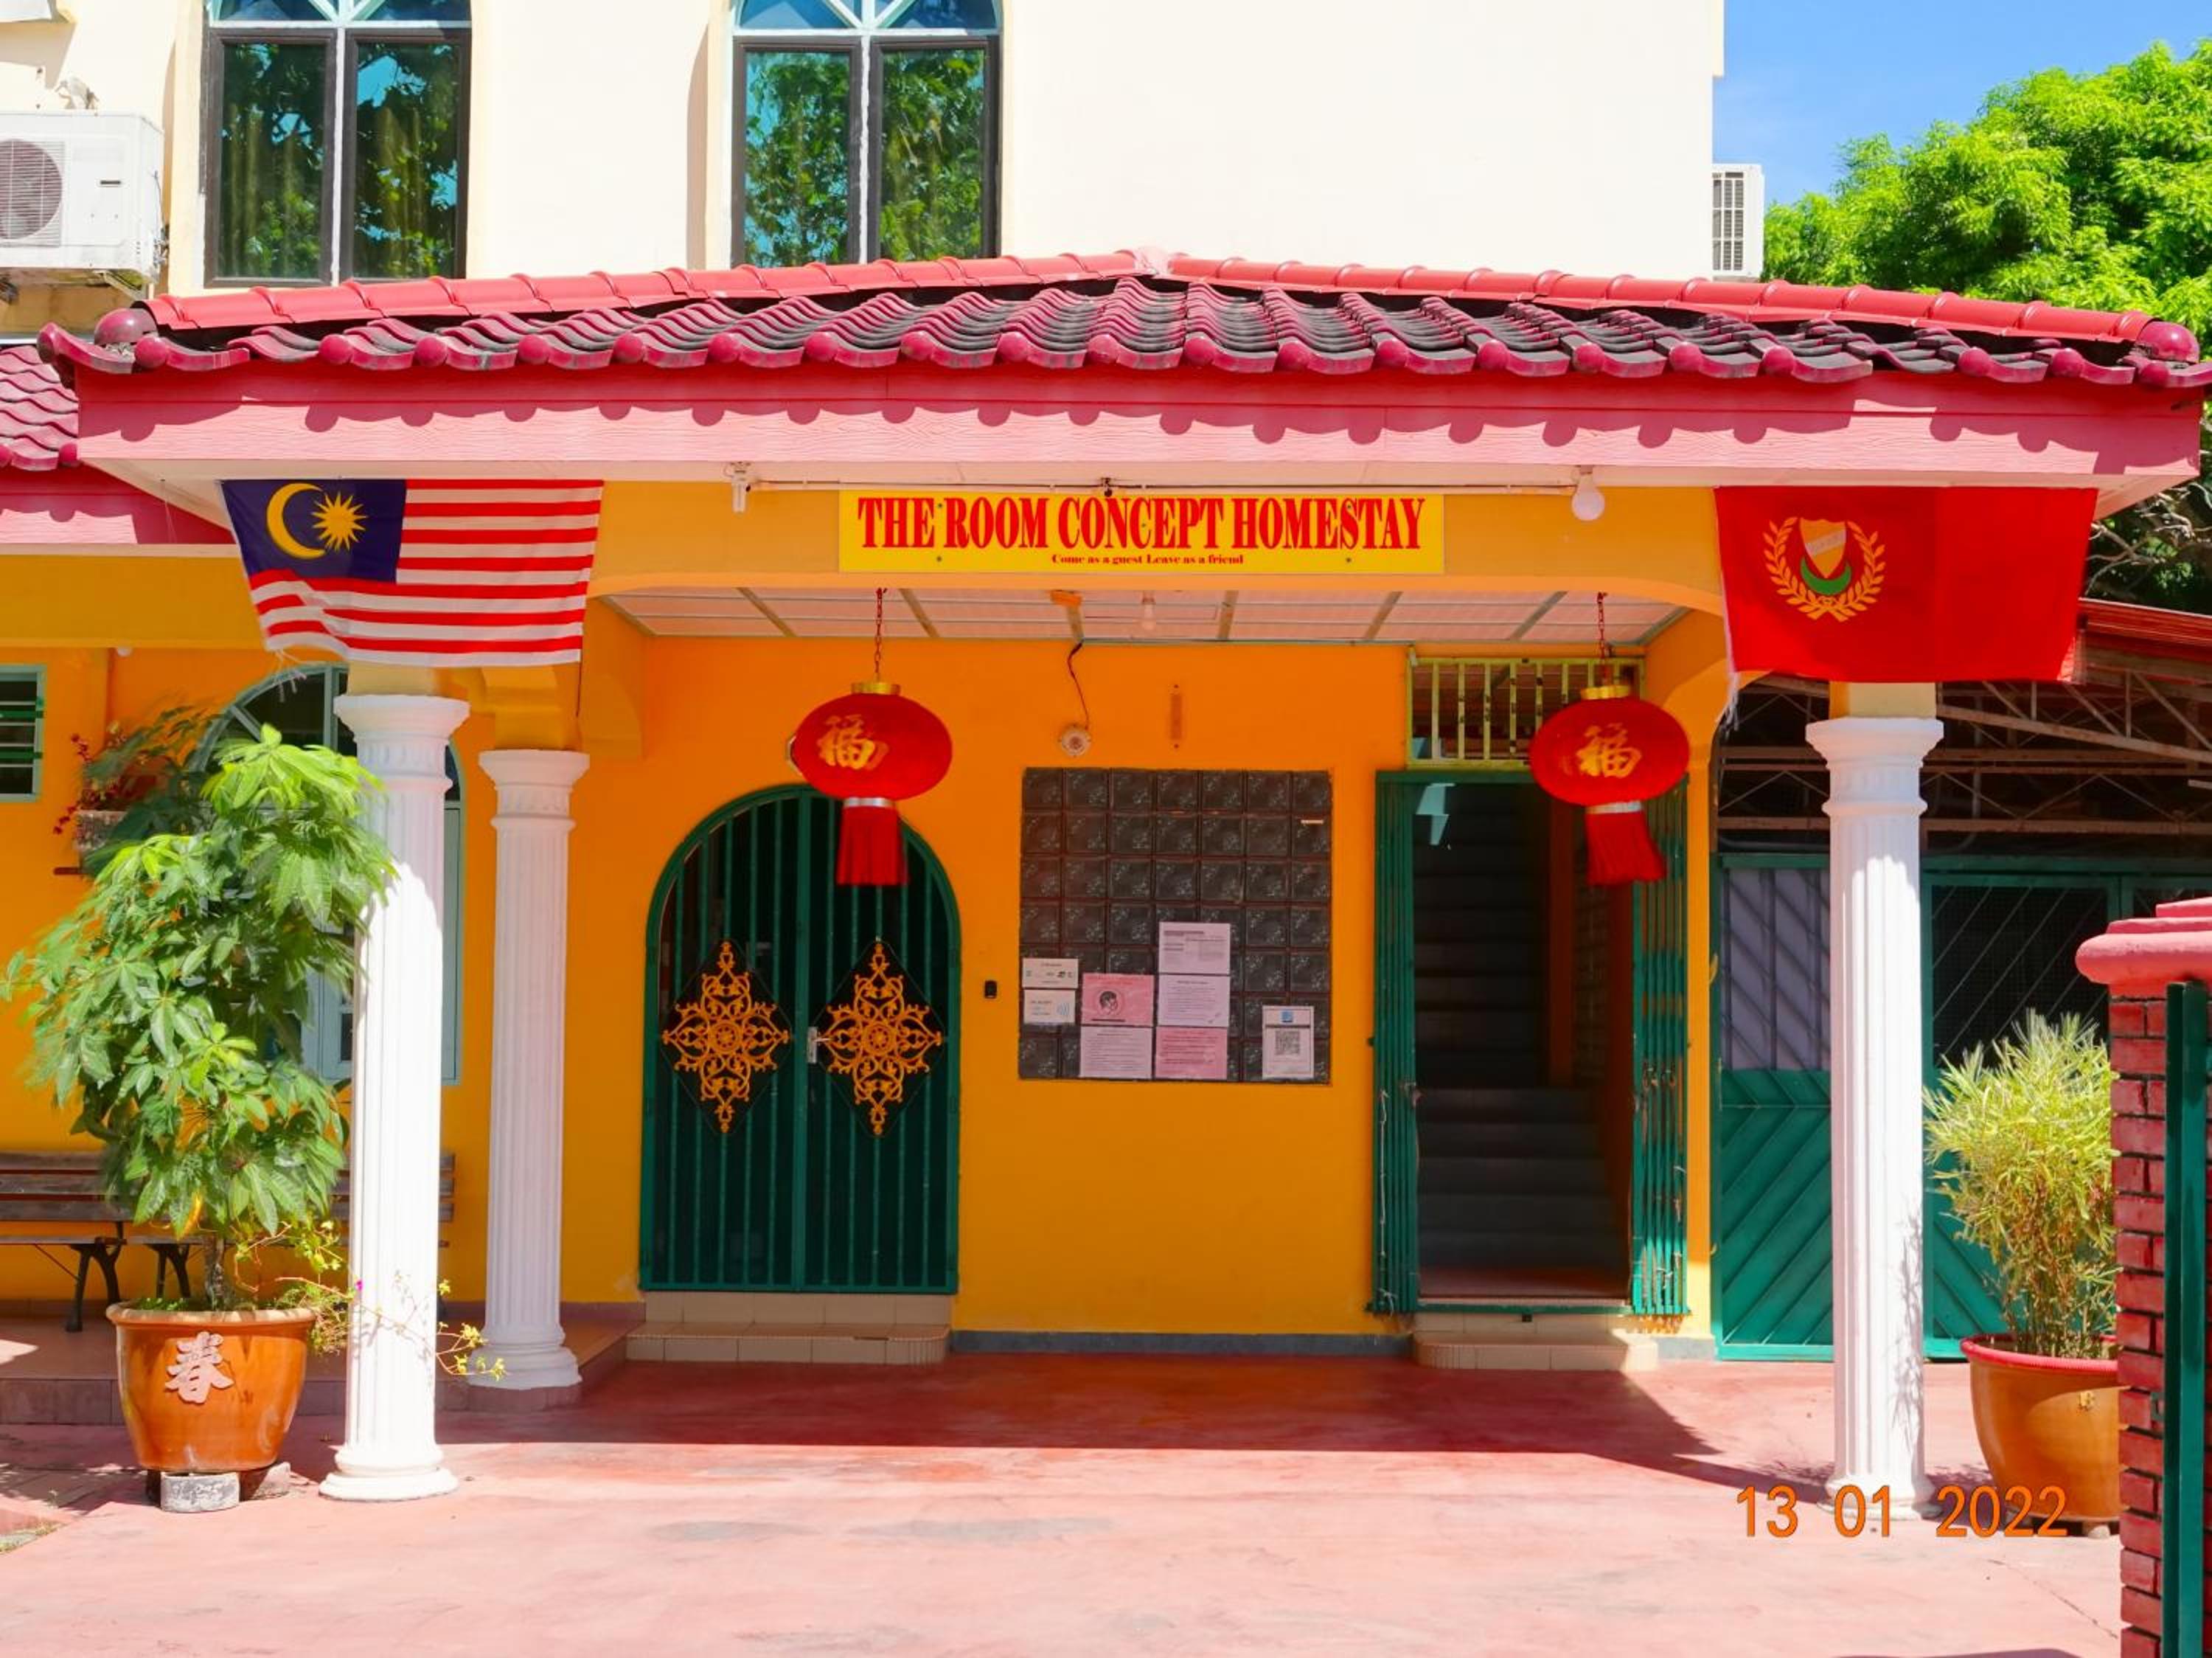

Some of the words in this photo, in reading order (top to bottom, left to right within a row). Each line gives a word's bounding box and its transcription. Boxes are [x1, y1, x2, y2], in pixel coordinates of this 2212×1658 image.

[858, 497, 934, 548] THE
[944, 497, 1049, 549] ROOM
[1058, 497, 1224, 549] CONCEPT
[1231, 497, 1425, 549] HOMESTAY
[1051, 554, 1085, 563] Come
[1088, 555, 1100, 563] as
[1112, 554, 1143, 565] guest
[1147, 554, 1180, 564] Leave
[1183, 555, 1195, 564] as
[1208, 554, 1243, 564] friend
[816, 714, 876, 769] 福
[1576, 723, 1642, 778] 福
[165, 1331, 234, 1404] 春
